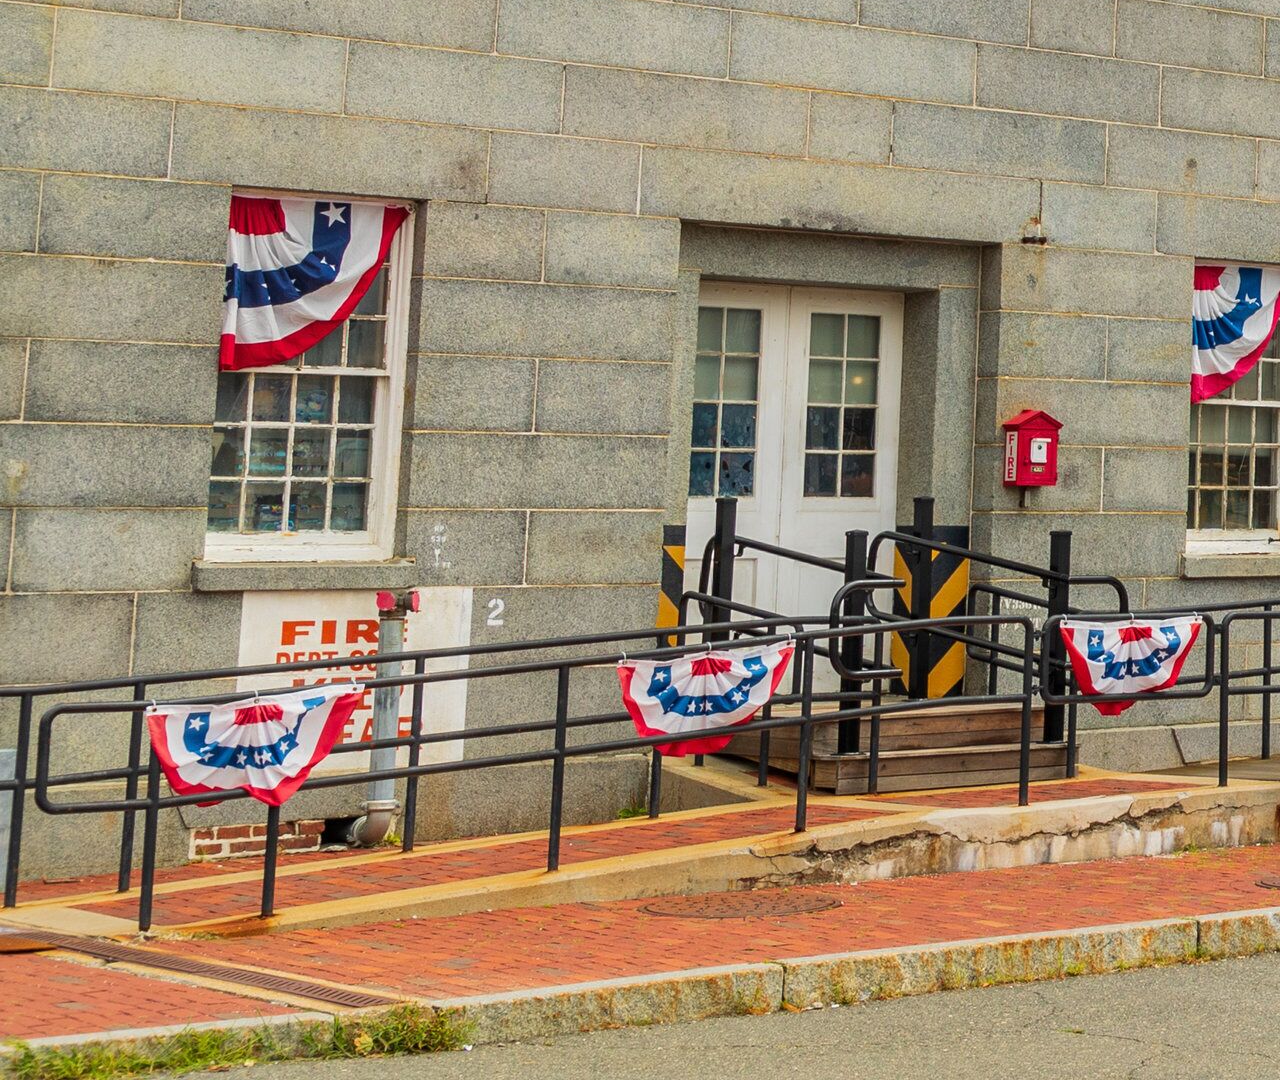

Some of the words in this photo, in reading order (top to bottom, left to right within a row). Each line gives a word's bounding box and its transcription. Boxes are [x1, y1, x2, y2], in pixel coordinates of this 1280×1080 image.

[1007, 434, 1015, 479] FIRE
[487, 598, 505, 626] 2
[281, 620, 408, 646] FIR
